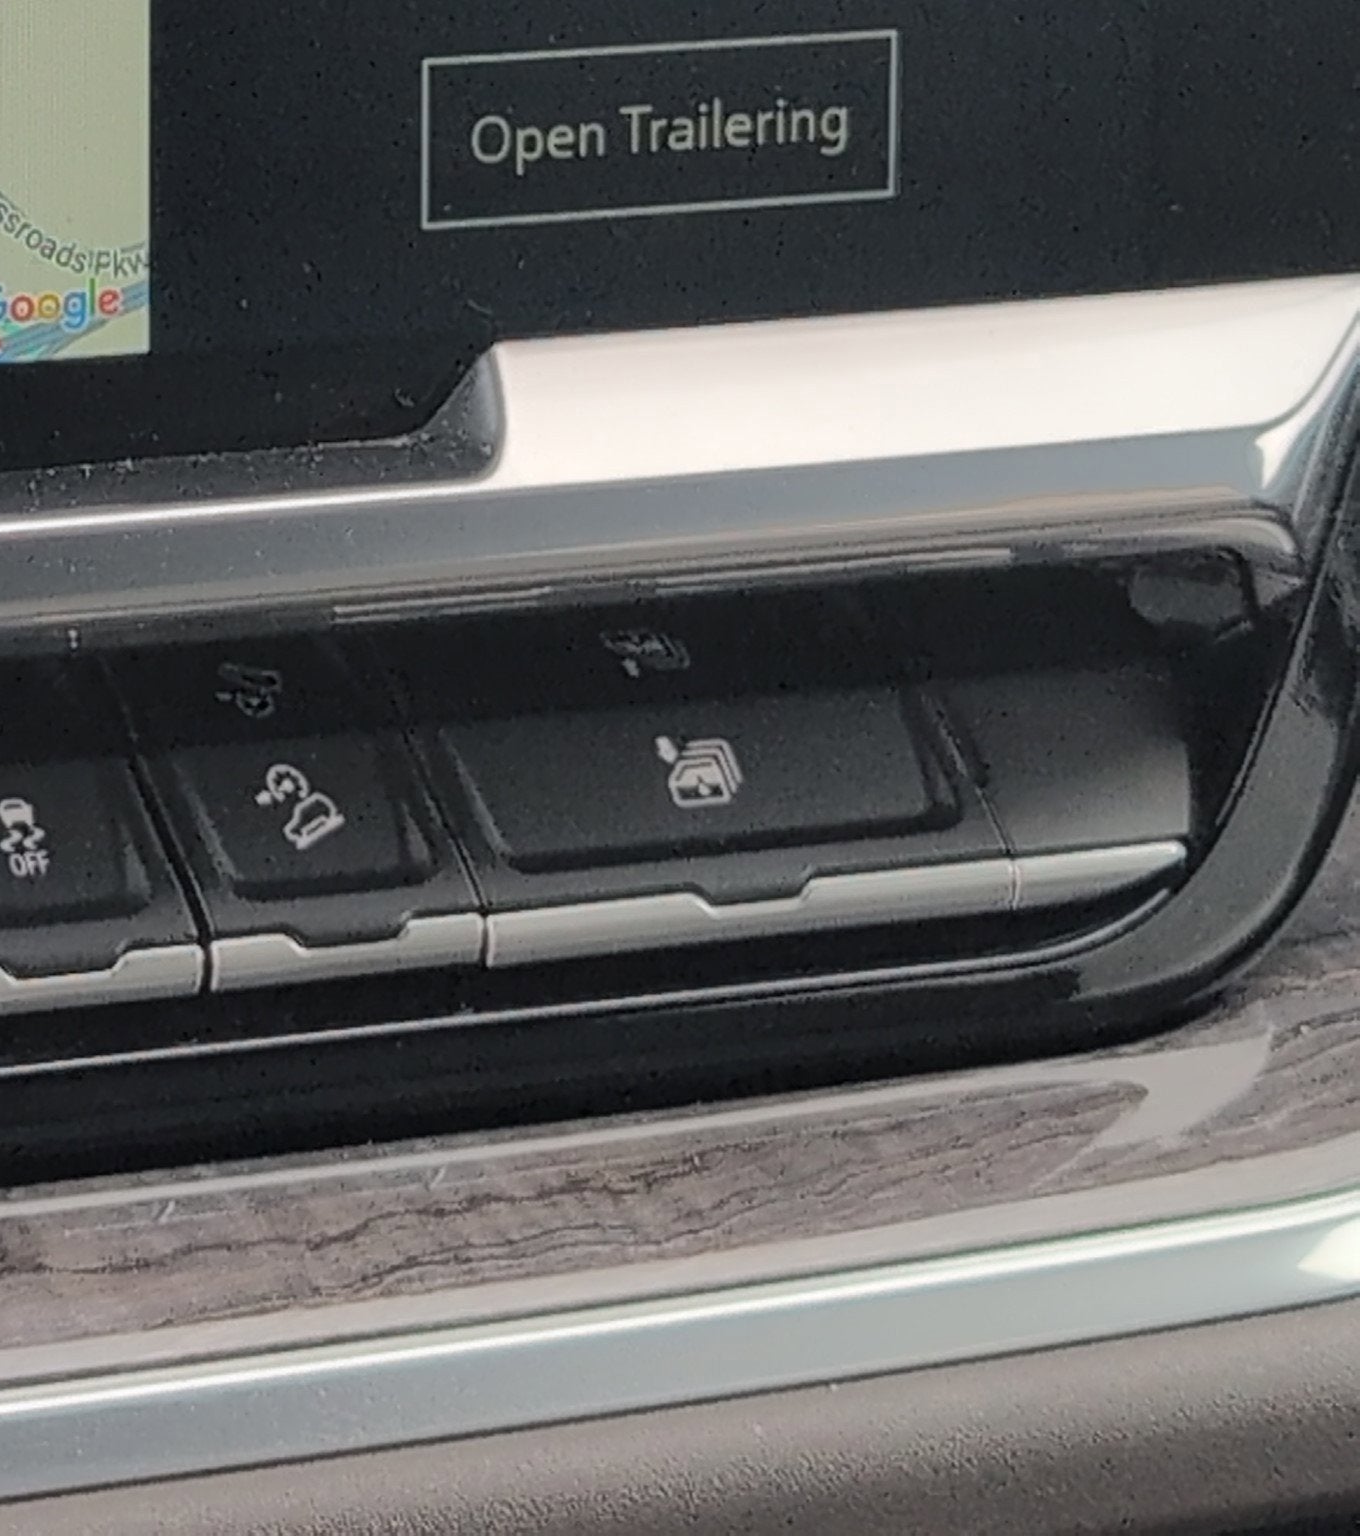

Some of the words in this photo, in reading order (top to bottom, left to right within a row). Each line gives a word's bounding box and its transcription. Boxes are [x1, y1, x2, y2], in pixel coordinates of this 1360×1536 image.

[471, 113, 606, 176] Open
[621, 97, 849, 157] Trailering
[9, 849, 50, 877] OFF
